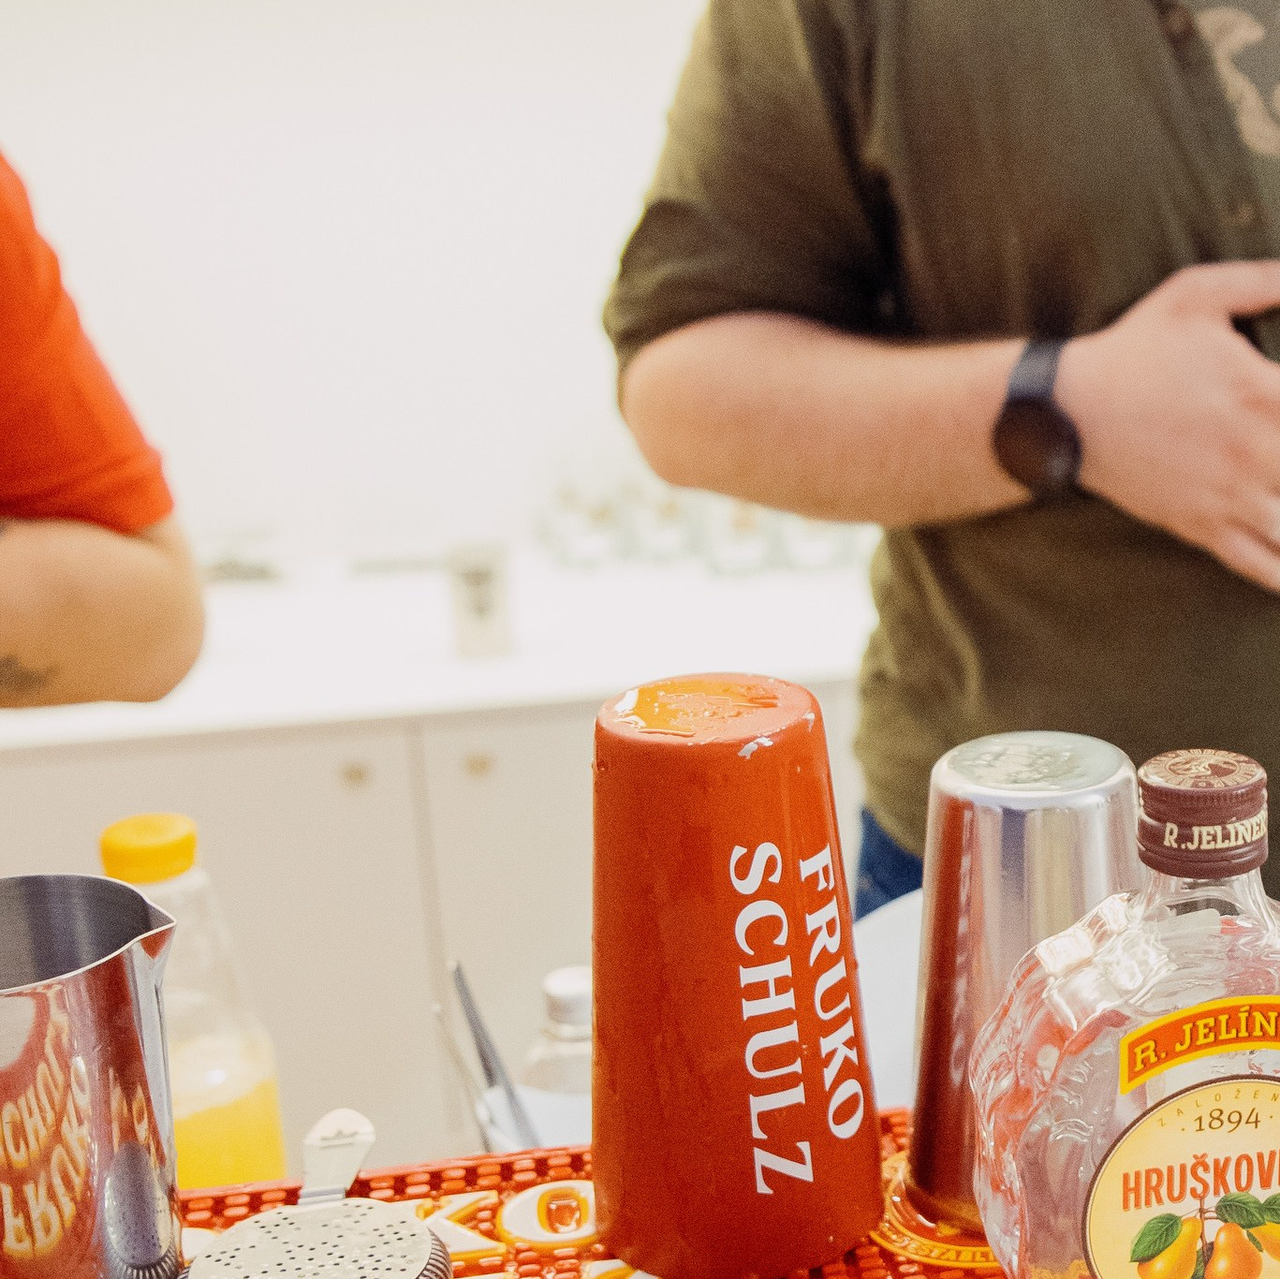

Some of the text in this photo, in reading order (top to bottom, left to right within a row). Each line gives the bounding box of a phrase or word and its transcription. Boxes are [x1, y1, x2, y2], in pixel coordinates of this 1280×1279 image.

[729, 841, 815, 1195] SCHULZ
[799, 843, 865, 1140] FRUKO
[1133, 1039, 1167, 1072] R.
[1193, 1107, 1261, 1133] 1894
